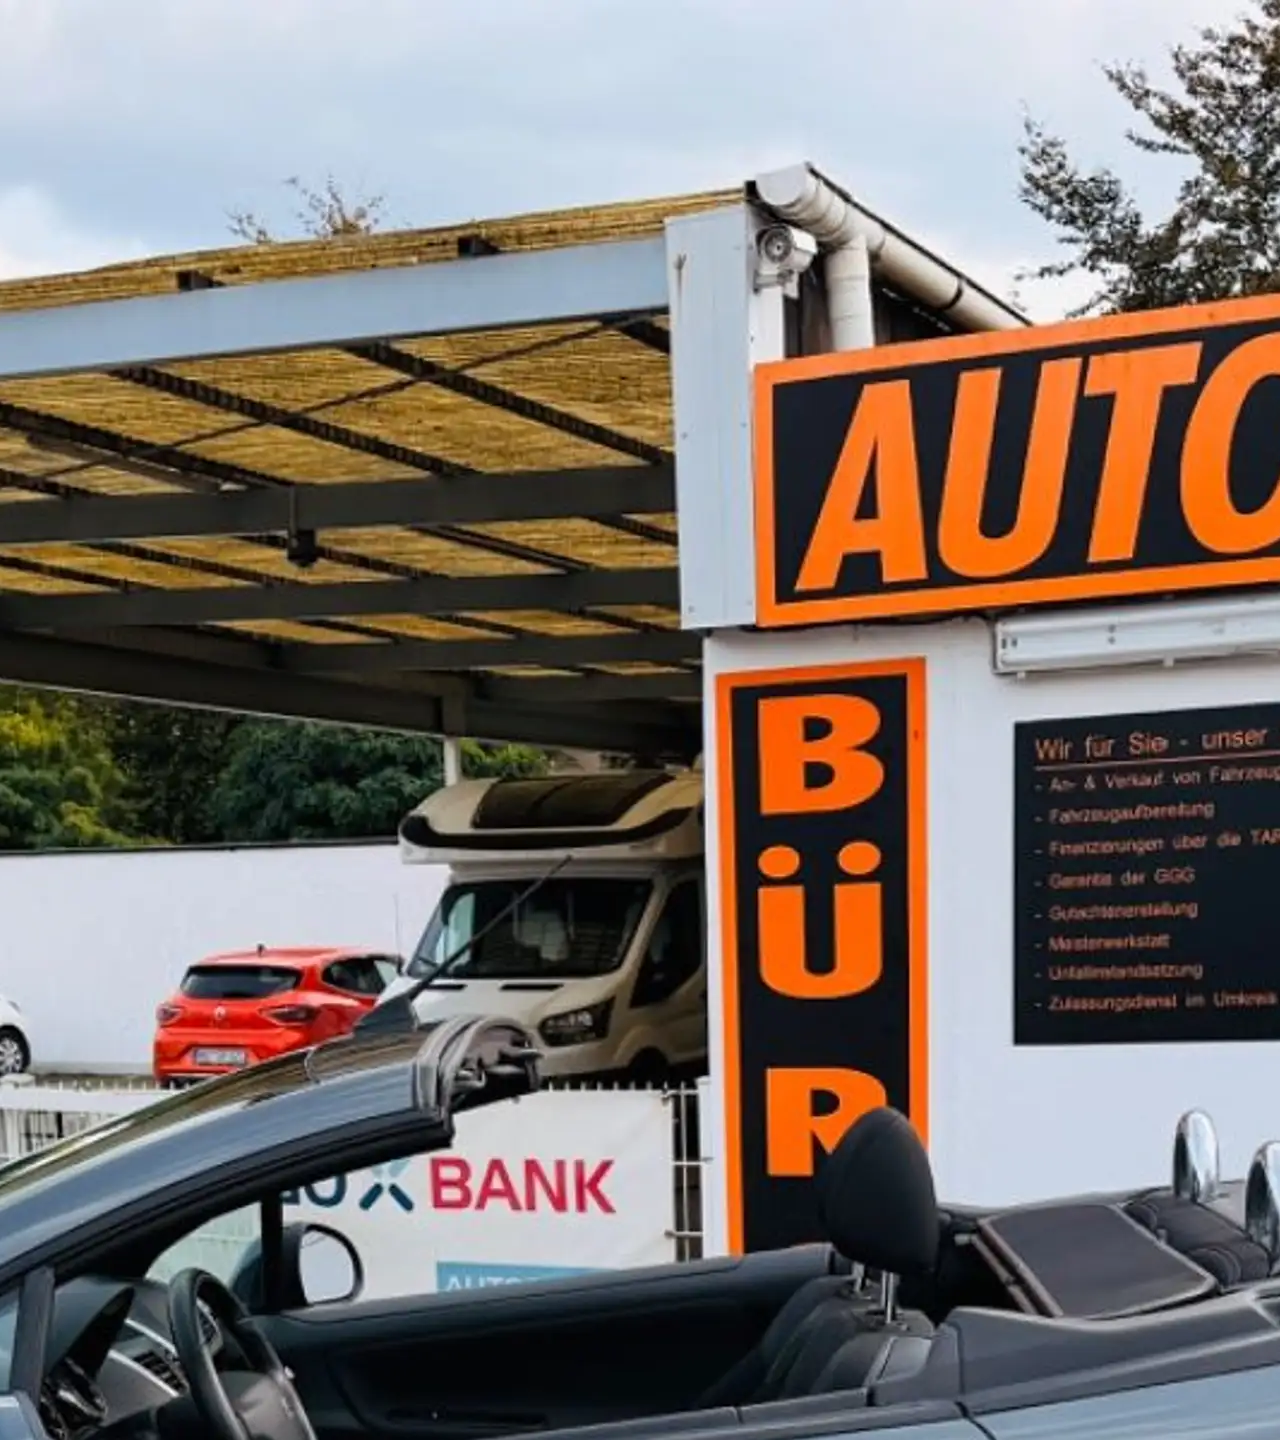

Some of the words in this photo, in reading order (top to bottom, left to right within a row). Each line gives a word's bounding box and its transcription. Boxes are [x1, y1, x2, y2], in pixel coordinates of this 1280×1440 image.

[1035, 737, 1072, 761] Wir
[1084, 732, 1116, 759] für
[1128, 731, 1169, 755] Sie
[1201, 728, 1268, 750] unser
[1105, 770, 1164, 790] Verkauf
[1172, 769, 1202, 785] von
[1049, 837, 1164, 857] Finanzierungen
[1216, 832, 1242, 848] die
[1120, 870, 1146, 885] der
